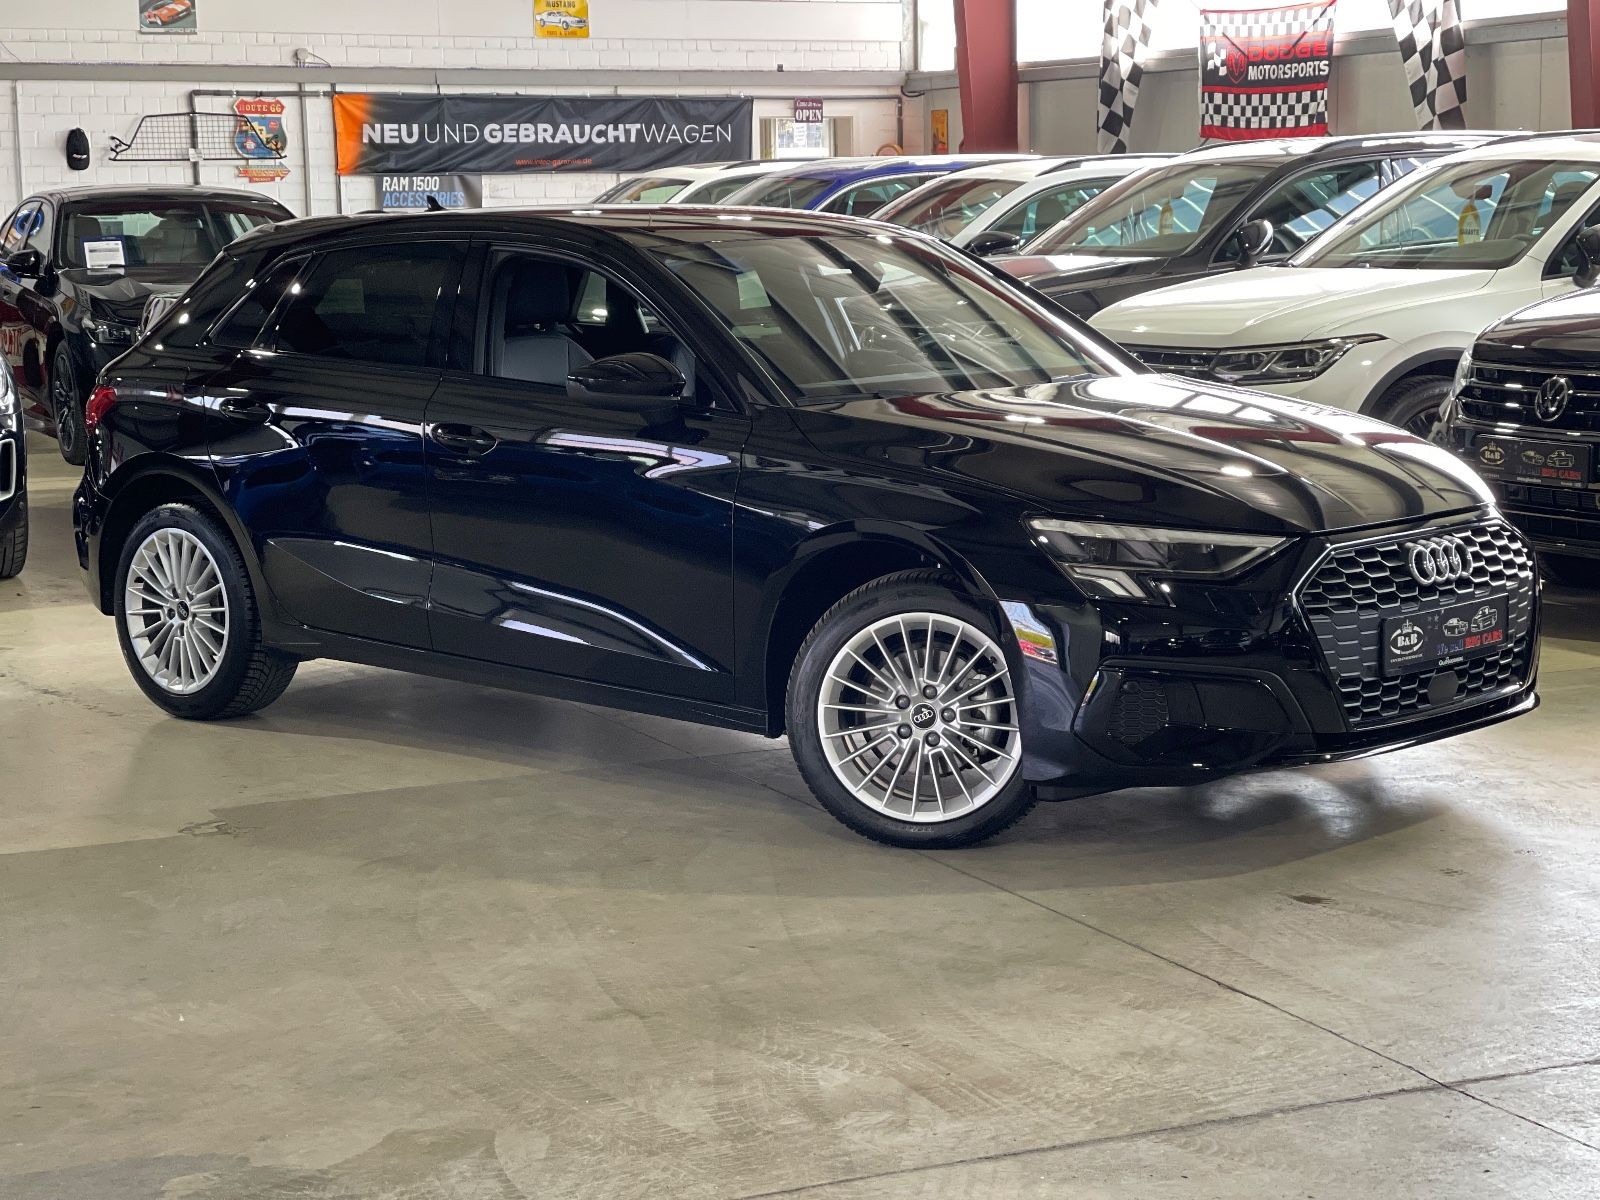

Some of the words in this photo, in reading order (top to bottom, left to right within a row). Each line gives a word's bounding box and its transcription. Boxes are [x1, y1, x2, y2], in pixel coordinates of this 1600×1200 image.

[545, 0, 576, 8] MUSTANG
[1247, 41, 1329, 62] DODGE
[1248, 60, 1329, 80] MOTORSPORTS
[270, 104, 281, 112] 66
[795, 109, 822, 121] OPEN
[382, 176, 409, 191] RAM
[412, 176, 440, 191] 1500
[1397, 634, 1418, 647] B&B
